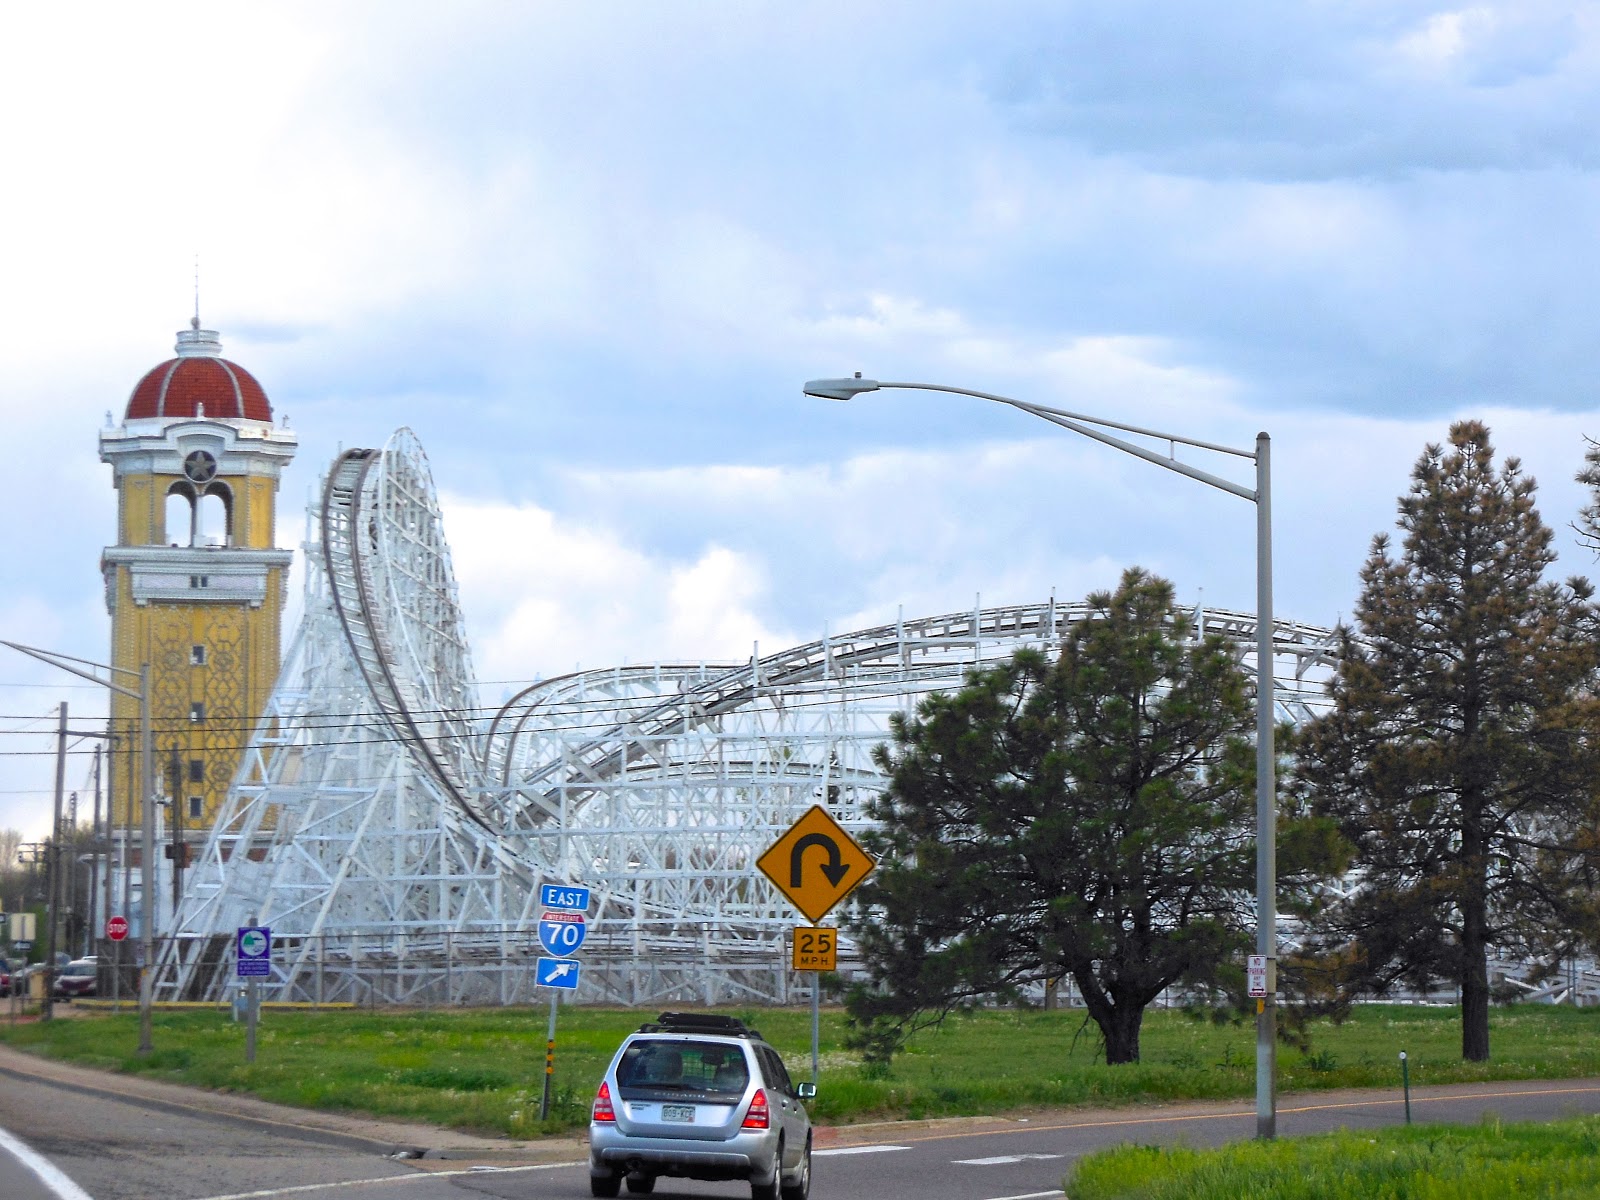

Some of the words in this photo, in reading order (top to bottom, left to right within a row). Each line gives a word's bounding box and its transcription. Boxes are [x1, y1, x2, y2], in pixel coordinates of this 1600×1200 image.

[547, 889, 582, 906] EAST
[546, 914, 580, 922] INTERSTATE
[109, 923, 127, 933] STOP
[547, 923, 579, 946] 70
[801, 934, 831, 953] 25
[801, 956, 828, 965] MPH
